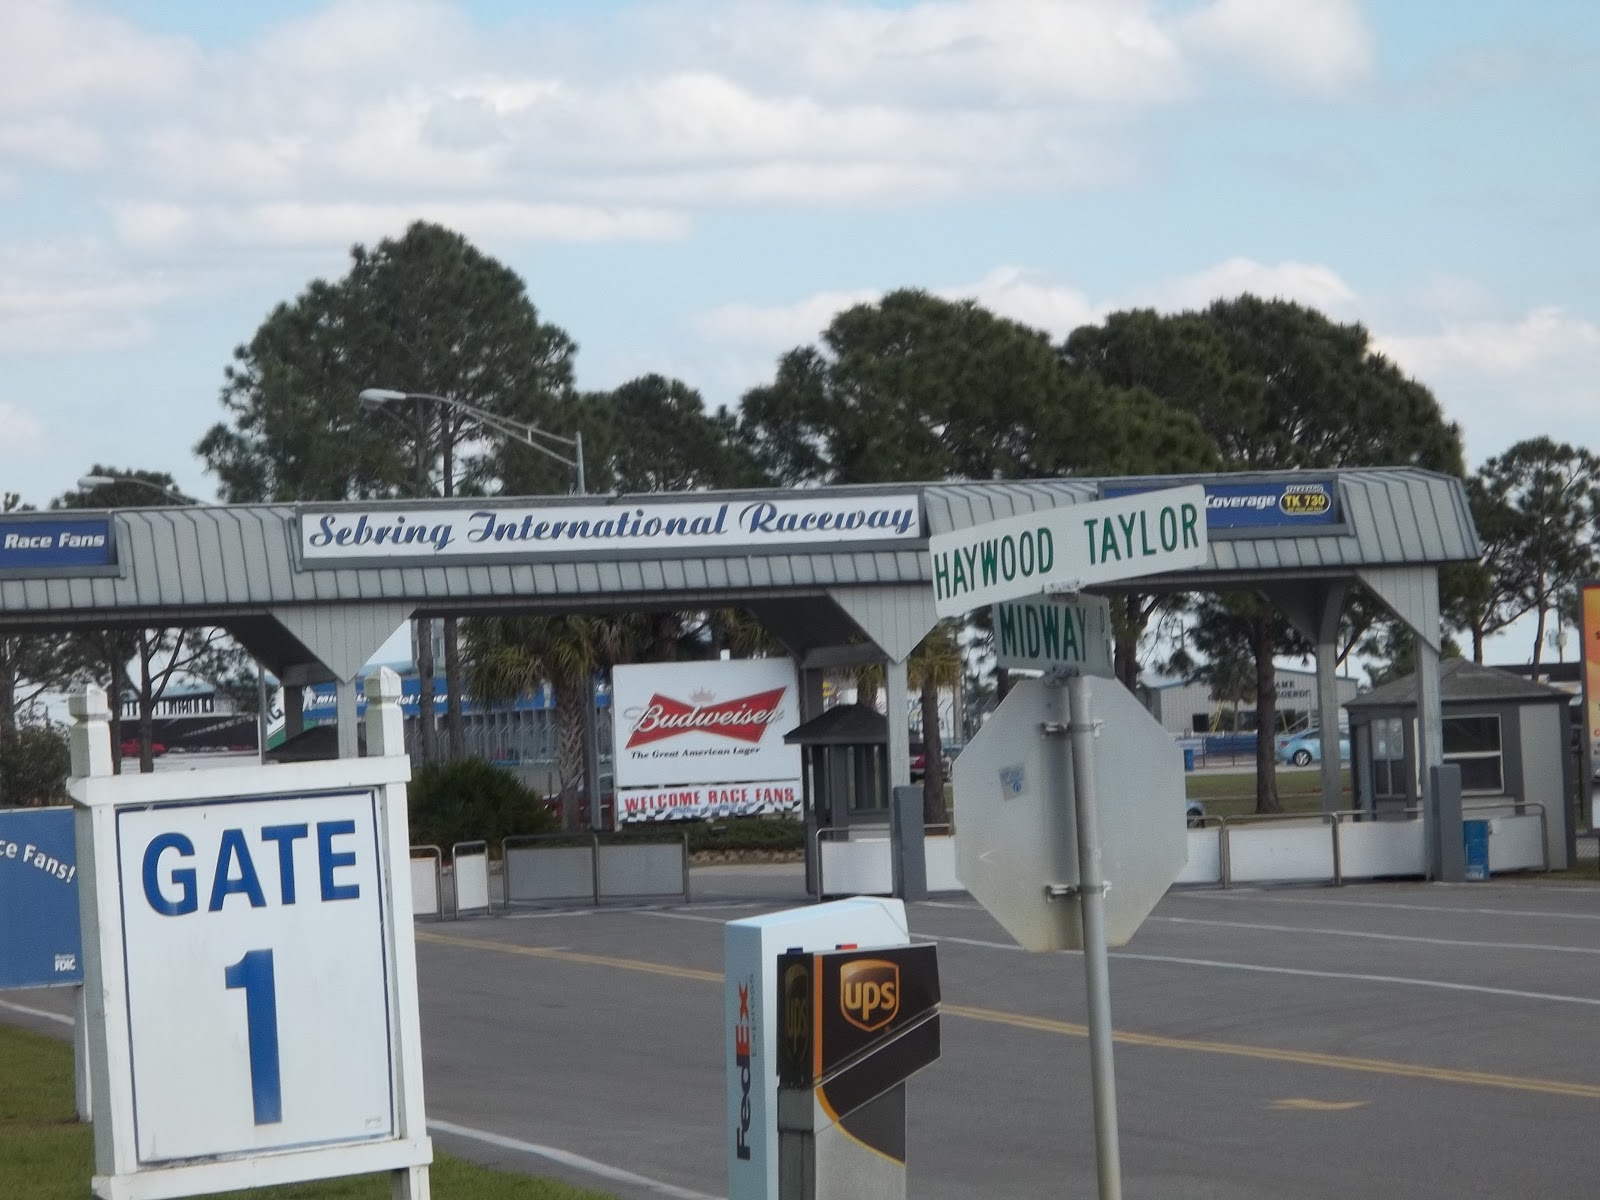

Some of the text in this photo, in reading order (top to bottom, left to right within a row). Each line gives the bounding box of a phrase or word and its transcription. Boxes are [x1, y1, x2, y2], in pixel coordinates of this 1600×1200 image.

[1206, 495, 1276, 509] Coverage
[1284, 495, 1301, 506] TK
[4, 532, 105, 549] Race Fans
[309, 501, 916, 551] Sebring International Raceway
[934, 503, 1199, 600] HAYWOOD TAYLOR
[999, 602, 1086, 663] MIDWAY
[624, 702, 784, 733] Budweiser
[631, 746, 761, 759] The Great American Lager
[624, 791, 701, 812] WELCOME
[708, 789, 747, 805] RACE
[755, 787, 795, 803] FANS
[23, 844, 76, 883] Fans!
[142, 819, 360, 917] GATE
[55, 959, 76, 972] FDIC
[845, 981, 896, 1020] ups
[224, 948, 282, 1126] 1
[737, 980, 751, 1160] FedEx
